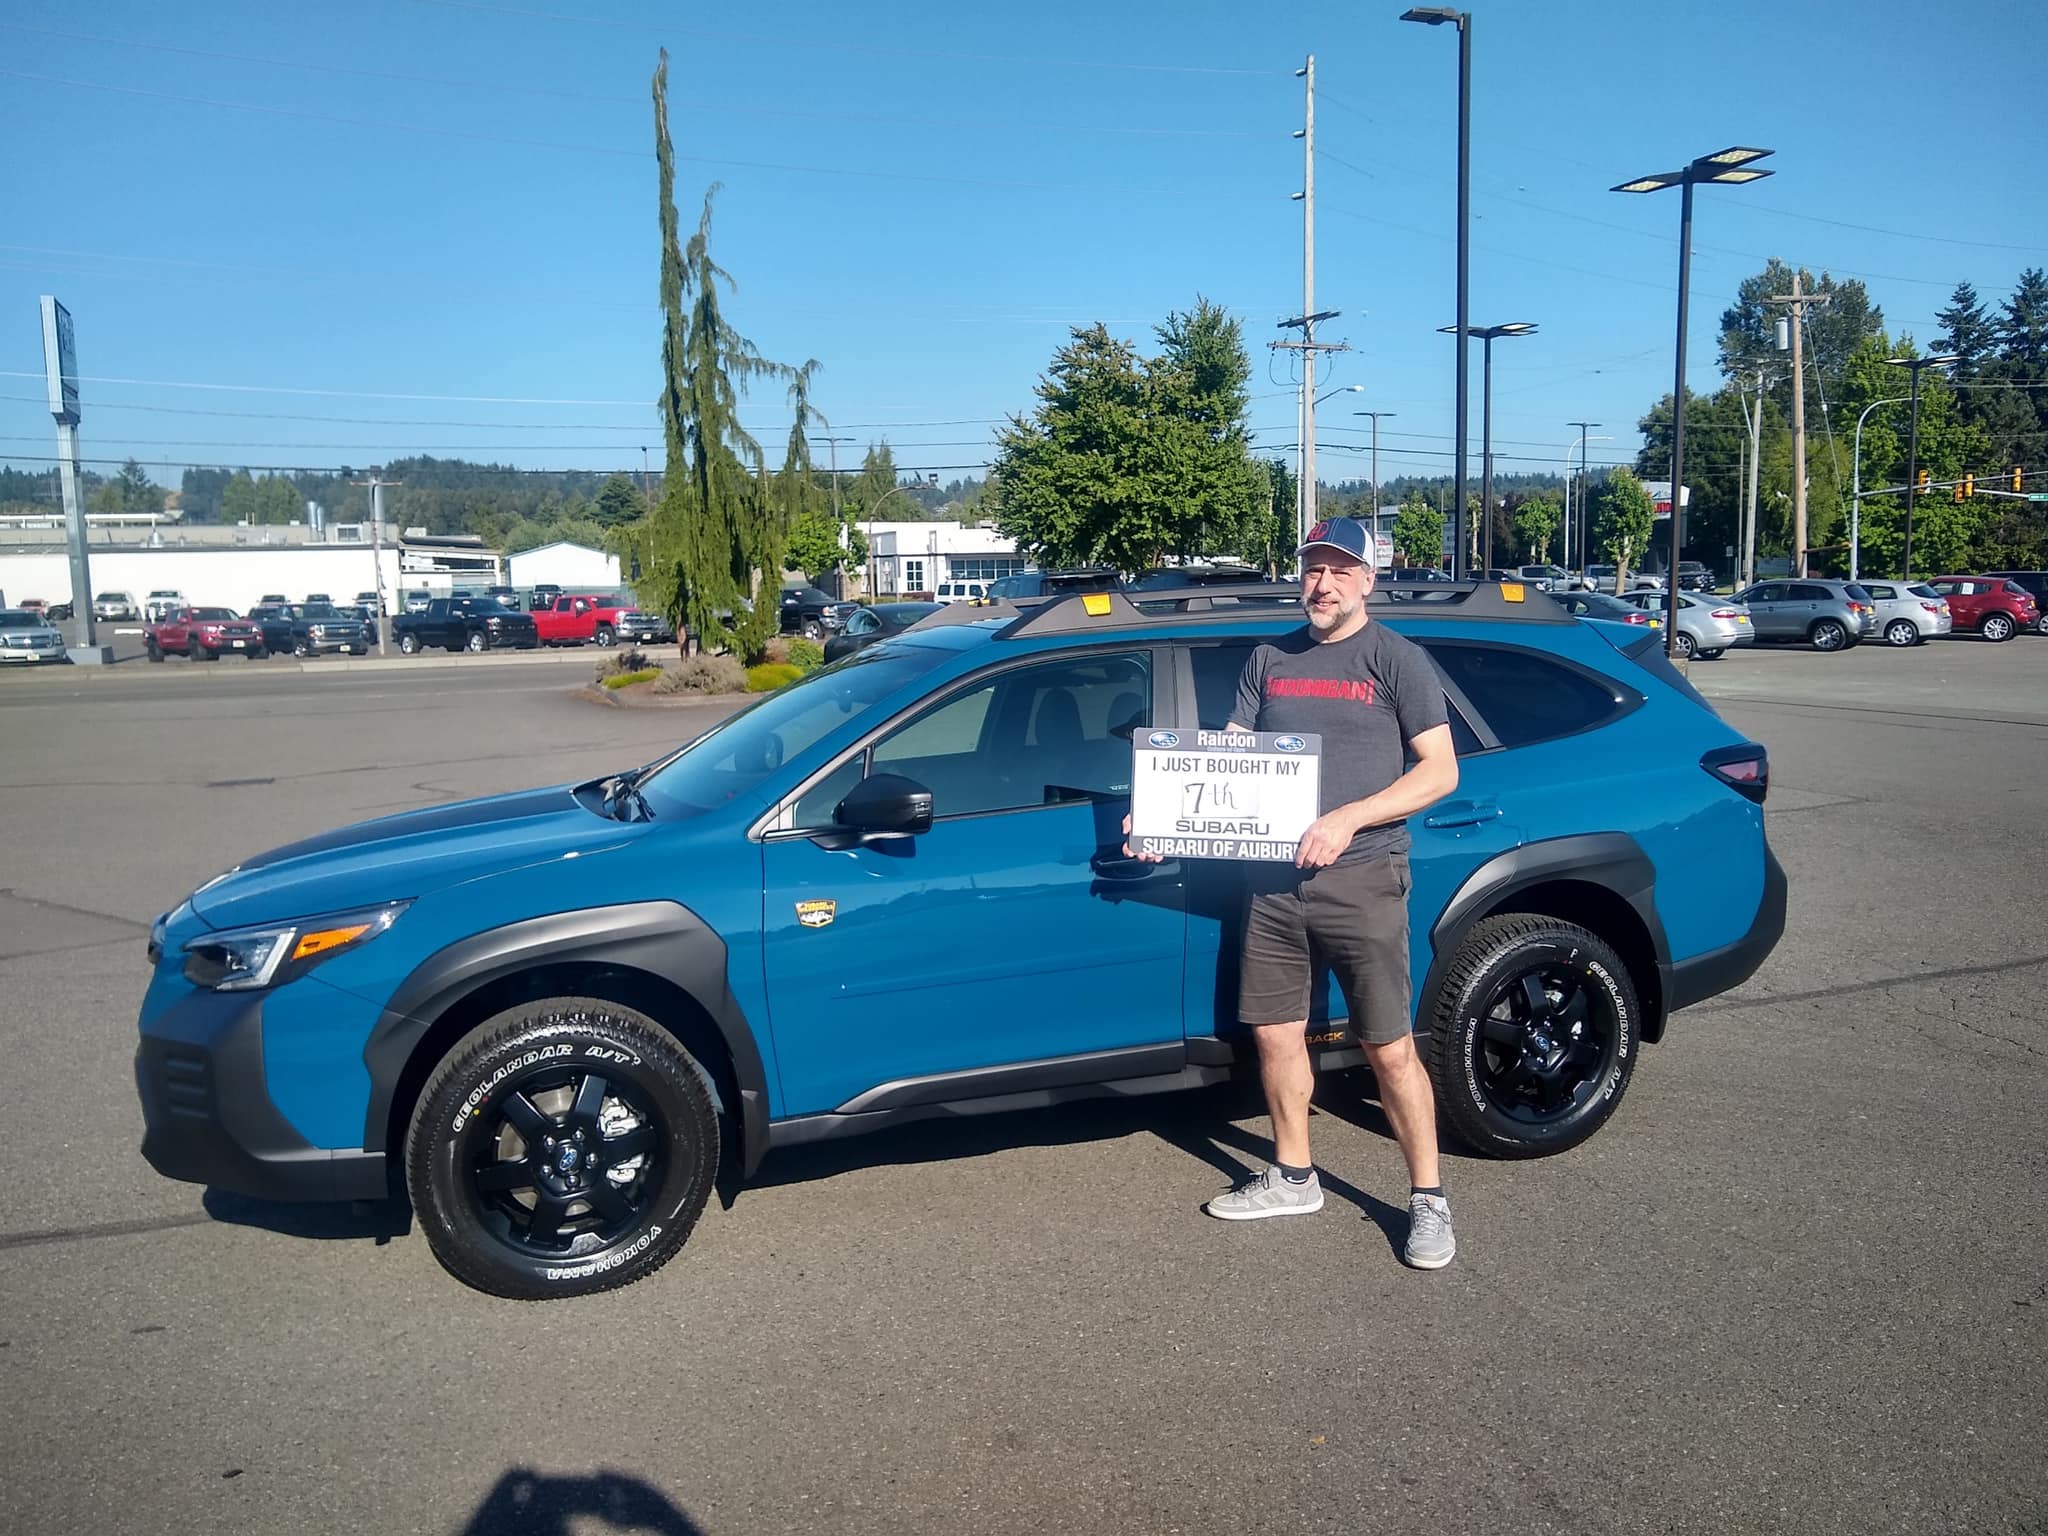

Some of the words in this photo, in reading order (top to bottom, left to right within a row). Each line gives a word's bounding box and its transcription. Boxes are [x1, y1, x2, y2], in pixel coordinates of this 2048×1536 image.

[1197, 731, 1256, 748] Rairdon
[1153, 757, 1157, 771] I
[1162, 757, 1201, 772] JUST
[1206, 759, 1270, 775] BOUGHT
[1276, 761, 1300, 776] MY
[1176, 820, 1270, 835] SUBARU
[1143, 837, 1208, 857] SUBARU
[1213, 841, 1235, 858] OF
[1589, 961, 1629, 1058] GEOLANDAR
[452, 1044, 574, 1133] GEOLANDAR
[547, 1224, 662, 1280] YOKOHAMA
